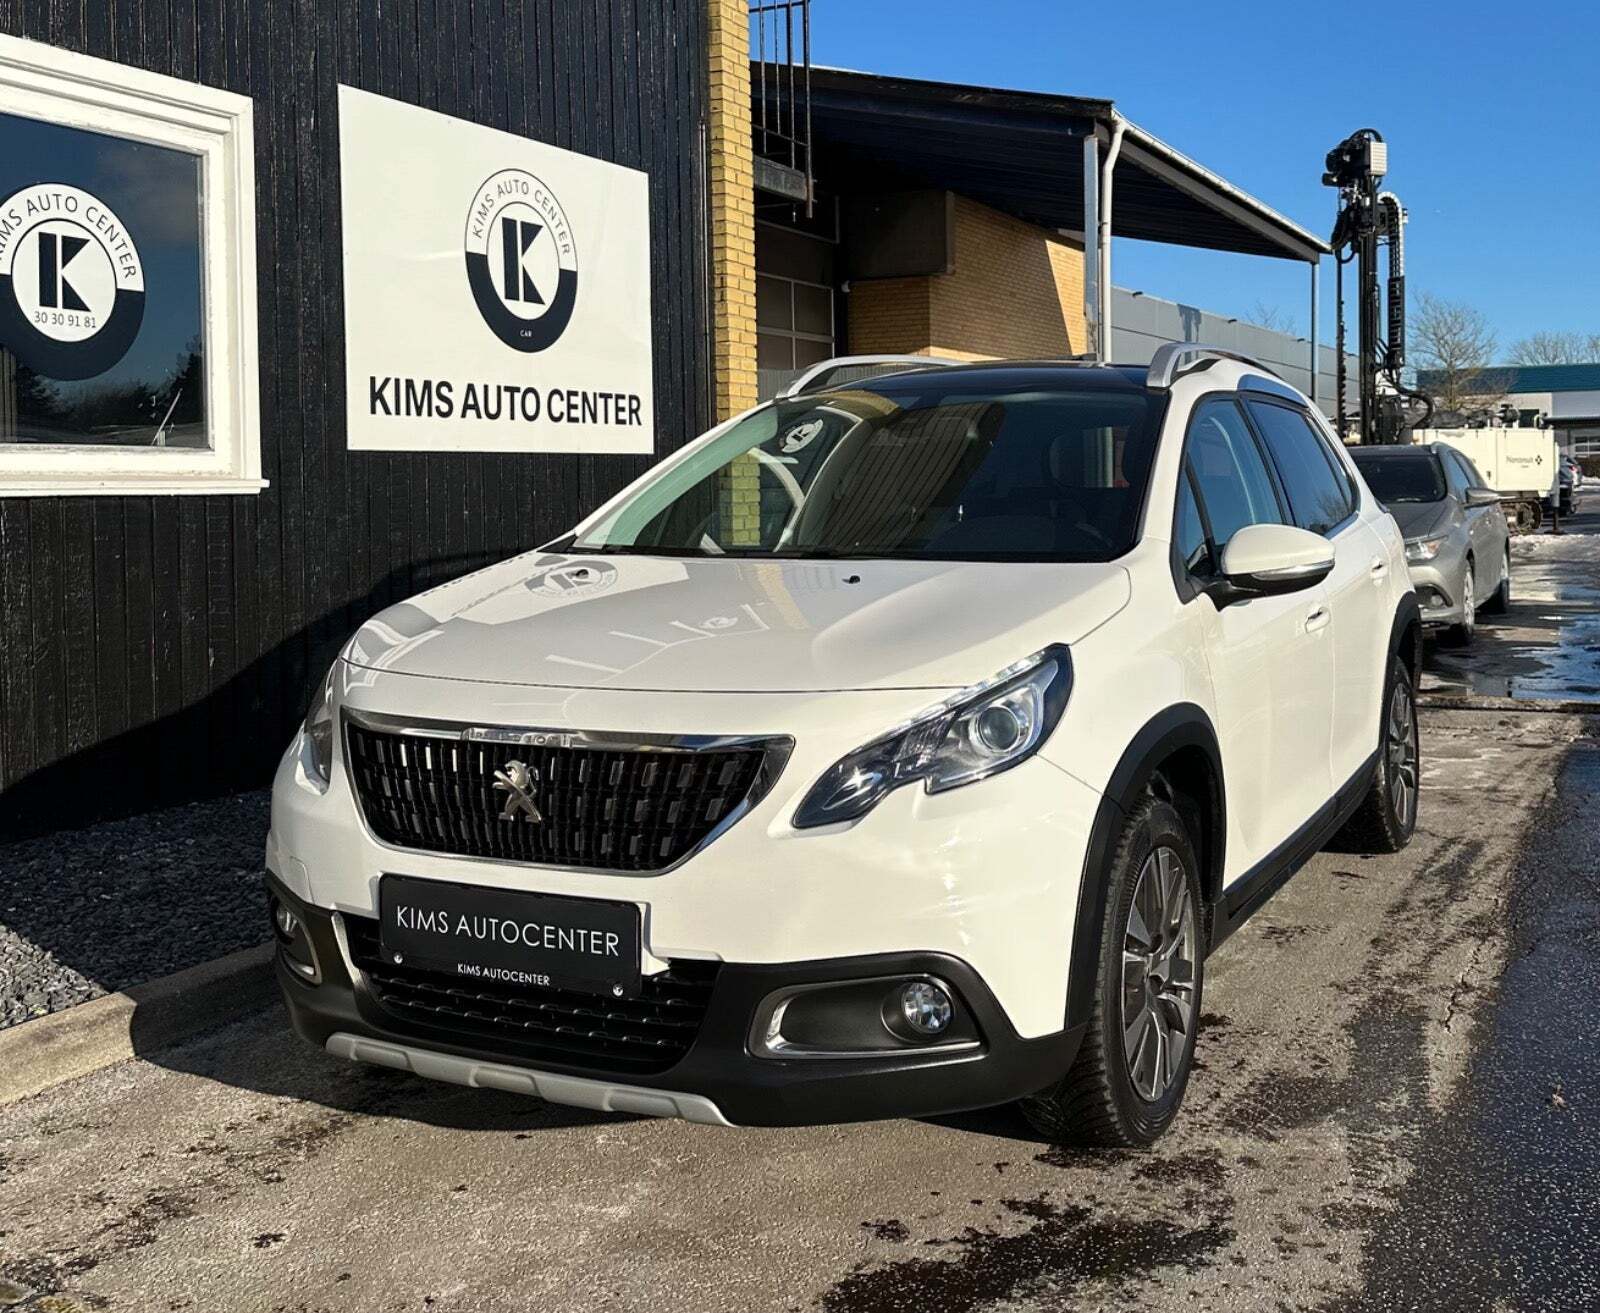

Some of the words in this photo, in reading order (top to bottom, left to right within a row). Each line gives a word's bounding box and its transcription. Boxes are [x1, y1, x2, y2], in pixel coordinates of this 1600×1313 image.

[0, 208, 23, 261] MS
[26, 193, 79, 217] AUTO
[85, 206, 137, 279] CENTER
[472, 193, 495, 239] KIMS
[497, 179, 530, 199] AUTO
[534, 189, 571, 256] CENTER
[38, 231, 92, 313] K
[502, 216, 546, 306] K
[34, 310, 48, 325] 30
[51, 312, 65, 326] 30
[67, 314, 80, 328] 91
[83, 315, 97, 329] 81
[369, 375, 454, 418] KIMS
[460, 382, 541, 422] AUTO
[547, 388, 642, 426] CENTER
[396, 905, 449, 934] KIMS
[455, 914, 619, 957] AUTOCENTER
[457, 963, 481, 977] KIMS
[482, 968, 550, 986] AUTOCENTER
